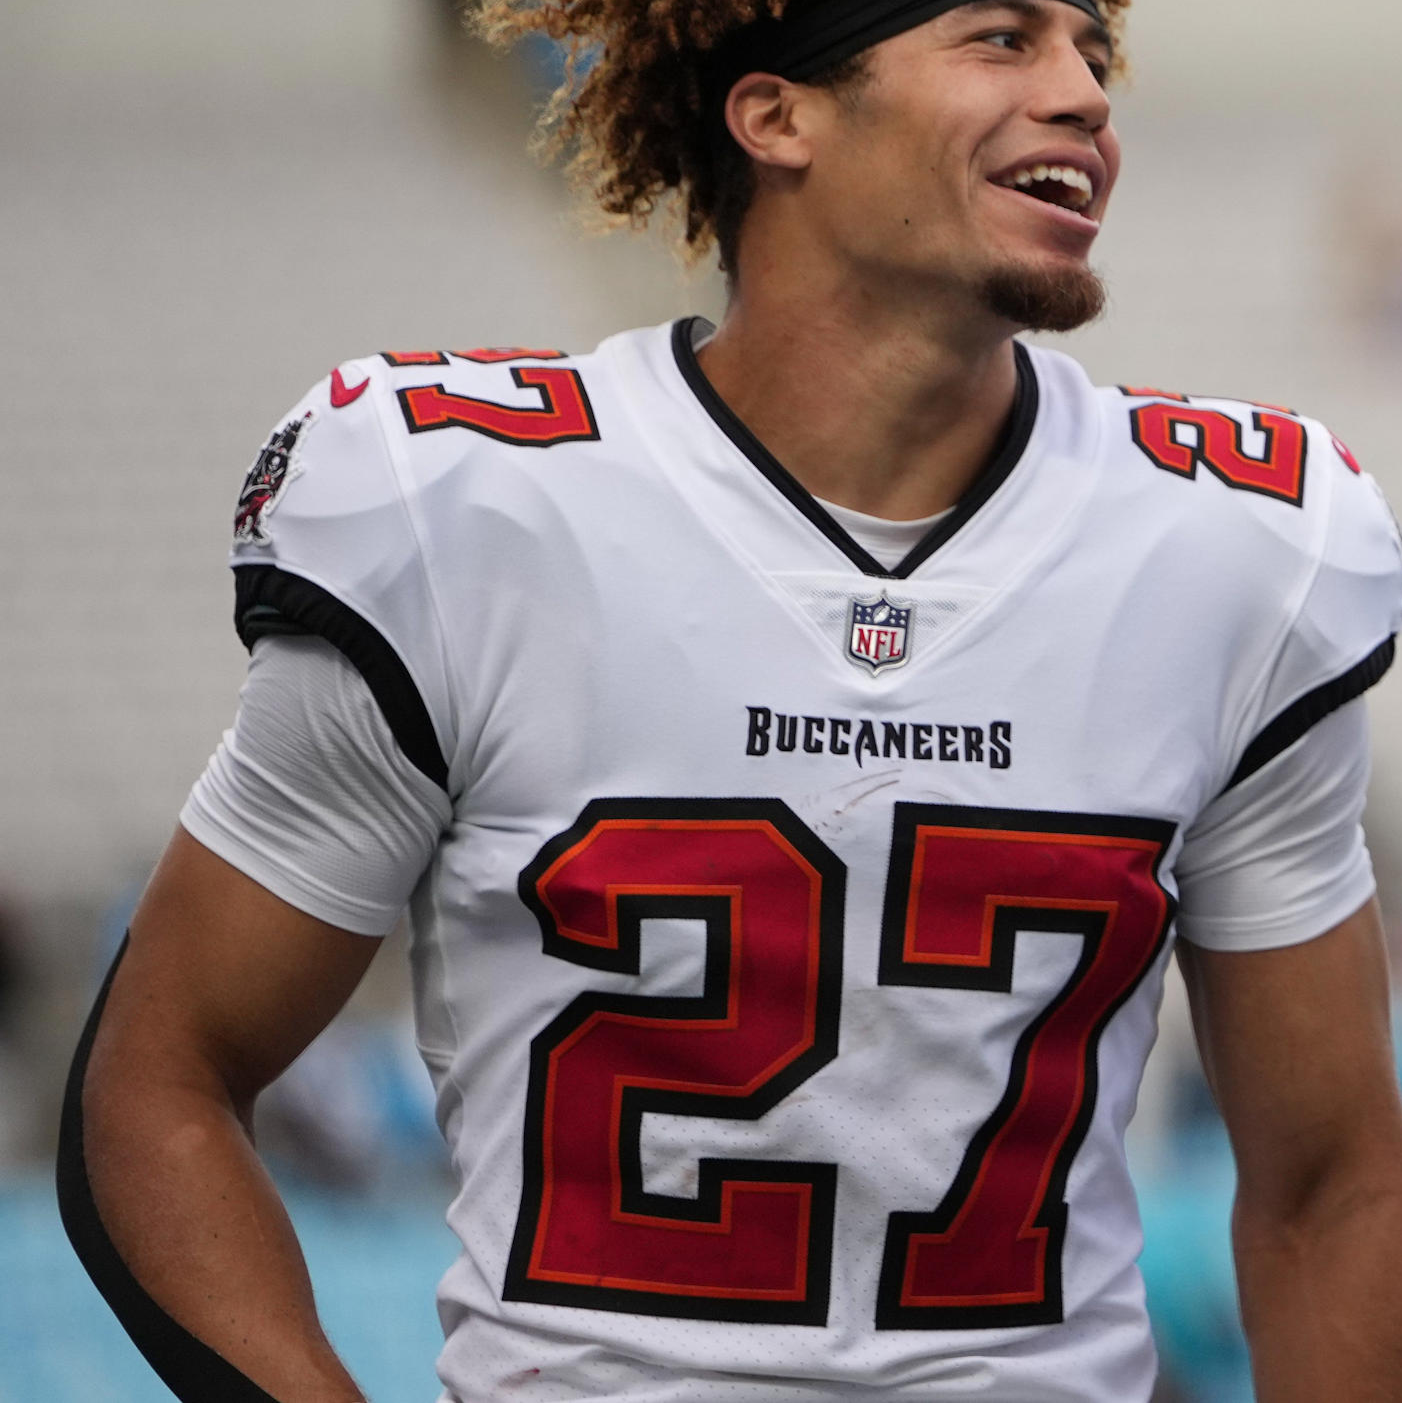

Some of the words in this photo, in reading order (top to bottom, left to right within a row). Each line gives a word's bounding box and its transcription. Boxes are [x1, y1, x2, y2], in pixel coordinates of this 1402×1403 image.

[856, 627, 901, 660] NFL
[745, 706, 1012, 769] BUCCANEERS
[502, 797, 1179, 1331] 27
